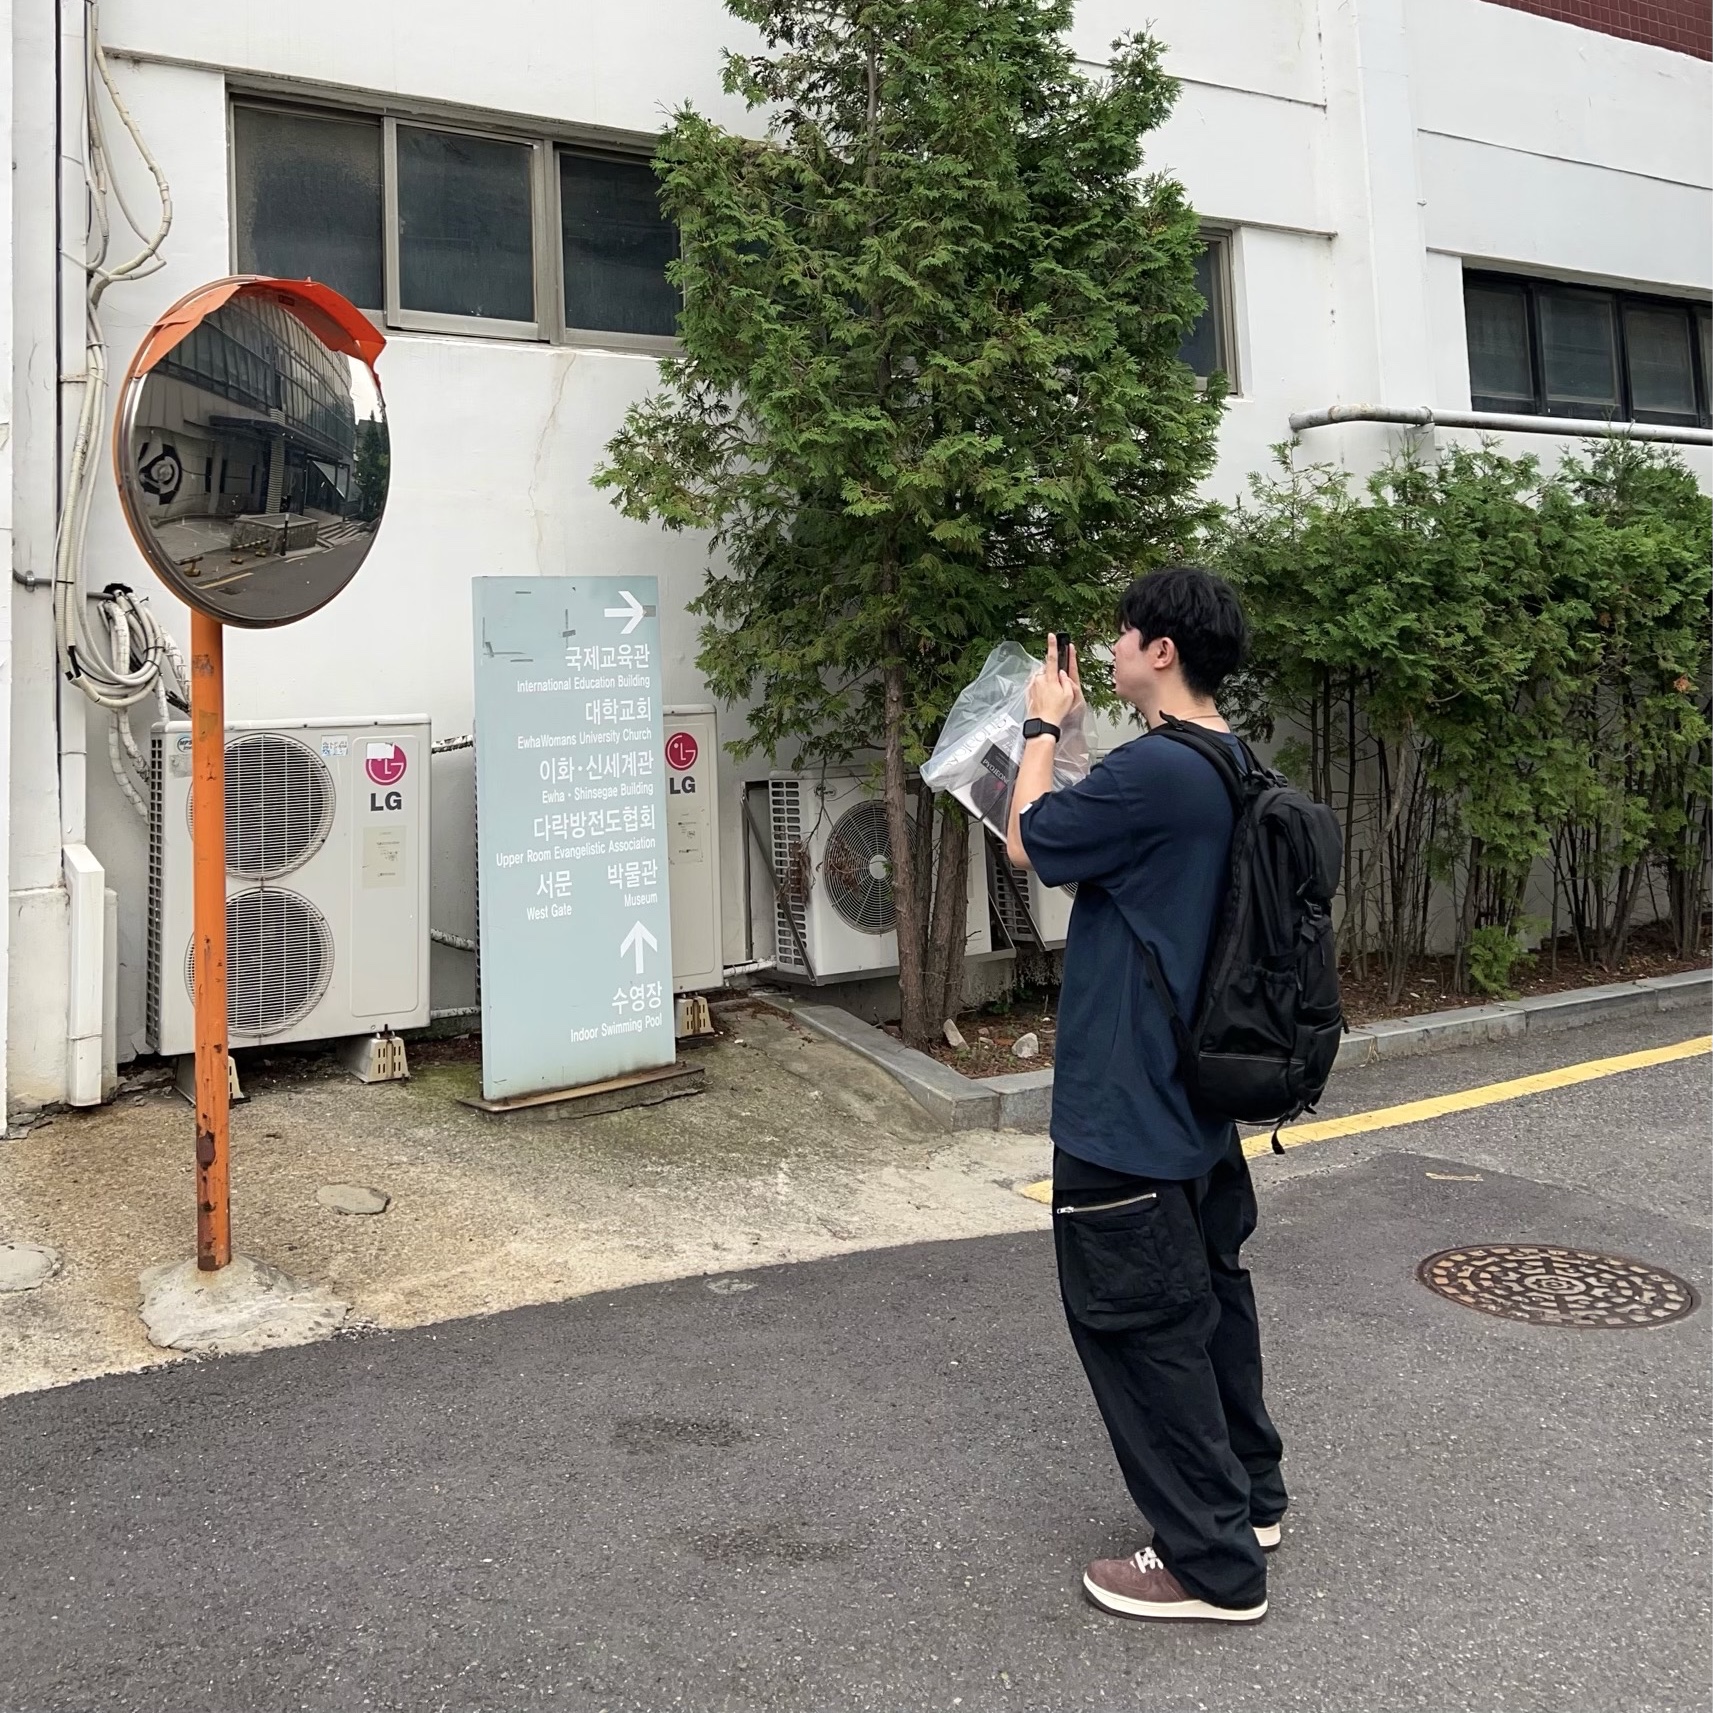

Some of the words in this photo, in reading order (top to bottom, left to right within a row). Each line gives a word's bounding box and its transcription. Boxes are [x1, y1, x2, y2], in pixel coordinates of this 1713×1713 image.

[565, 644, 650, 671] 국제교육관
[517, 678, 571, 692] International
[574, 676, 615, 689] Education
[618, 674, 650, 688] Building
[586, 697, 651, 725] 대학교회
[579, 730, 620, 744] University
[623, 727, 651, 741] Church
[543, 789, 565, 803] Ewha
[575, 787, 618, 800] Shinsegae
[621, 782, 653, 796] Building
[669, 776, 696, 794] LG
[370, 791, 402, 812] LG
[534, 804, 655, 841] 다락방전도협회
[496, 853, 524, 868] Upper
[527, 850, 551, 862] Room
[554, 842, 605, 859] Evangelistic
[609, 836, 655, 853] Association
[537, 870, 572, 898] 서문
[608, 859, 658, 889] 박물관
[527, 905, 548, 920] West
[551, 903, 572, 917] Gate
[624, 893, 657, 907] Museum
[612, 981, 662, 1014] 수영장
[571, 1028, 598, 1042] Indoor
[601, 1019, 642, 1036] Swimming
[645, 1013, 662, 1028] Pool
